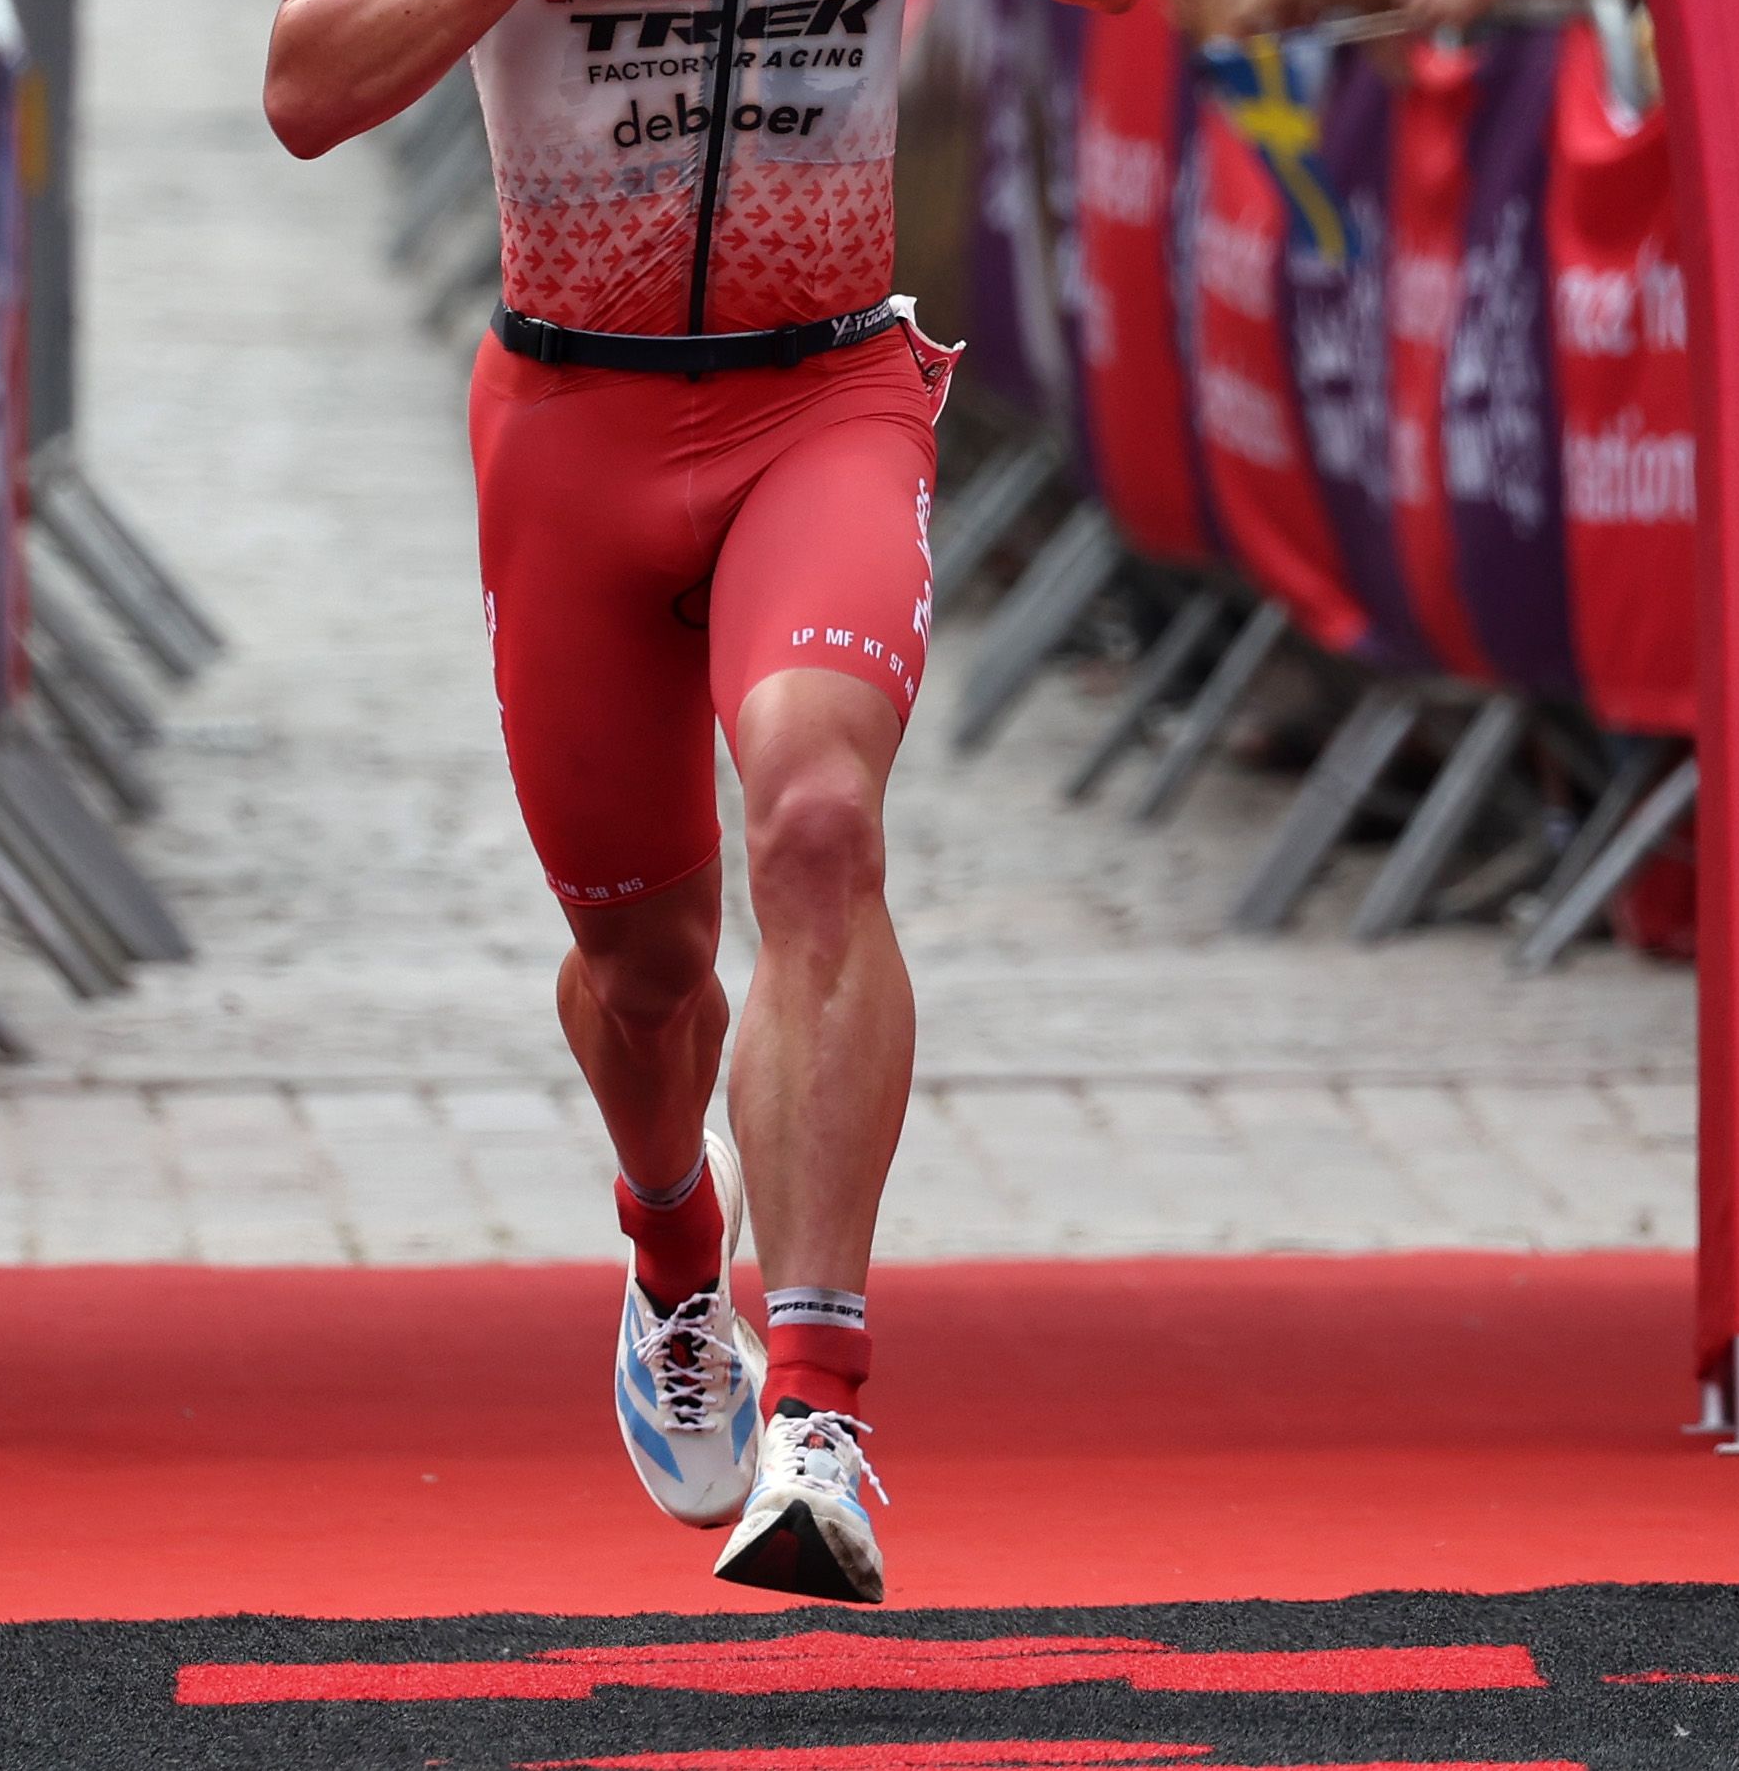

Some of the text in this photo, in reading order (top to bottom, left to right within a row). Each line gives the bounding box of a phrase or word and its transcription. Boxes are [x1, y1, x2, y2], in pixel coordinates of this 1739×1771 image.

[588, 48, 864, 84] FACTORY RACING
[613, 93, 824, 148] deboer
[791, 627, 815, 647] LP
[825, 627, 854, 649] MF
[863, 637, 885, 660] KT
